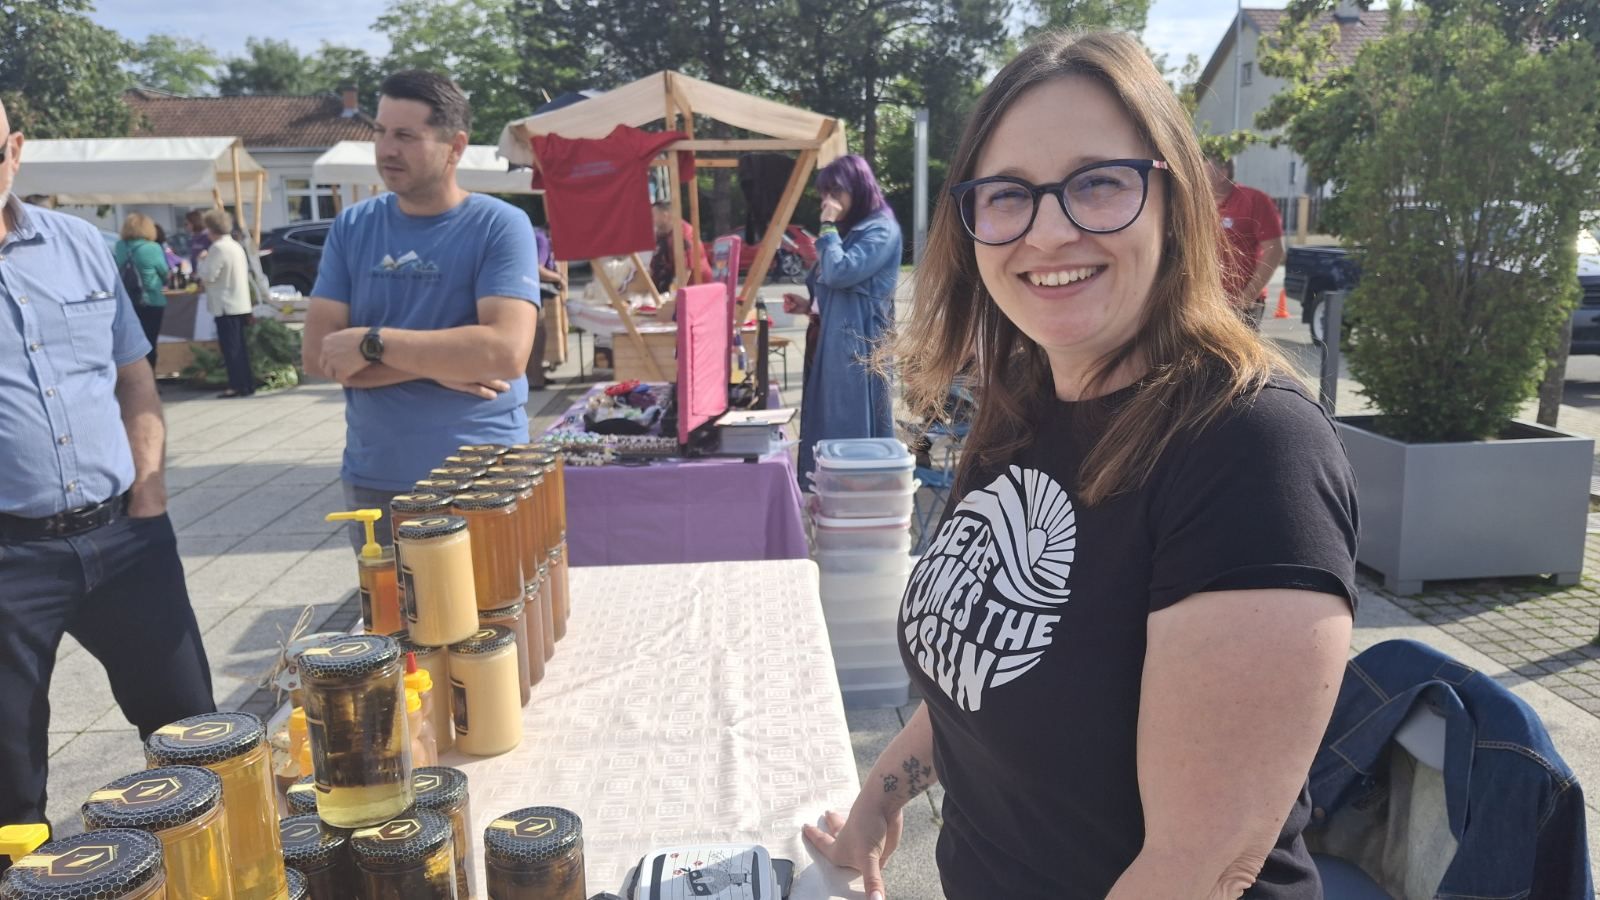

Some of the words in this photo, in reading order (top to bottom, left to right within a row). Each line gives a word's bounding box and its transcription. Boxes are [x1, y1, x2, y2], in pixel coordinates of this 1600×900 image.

[923, 516, 998, 582] HERE
[902, 556, 983, 630] COMES
[976, 599, 1061, 650] THE
[917, 615, 997, 712] SUN
